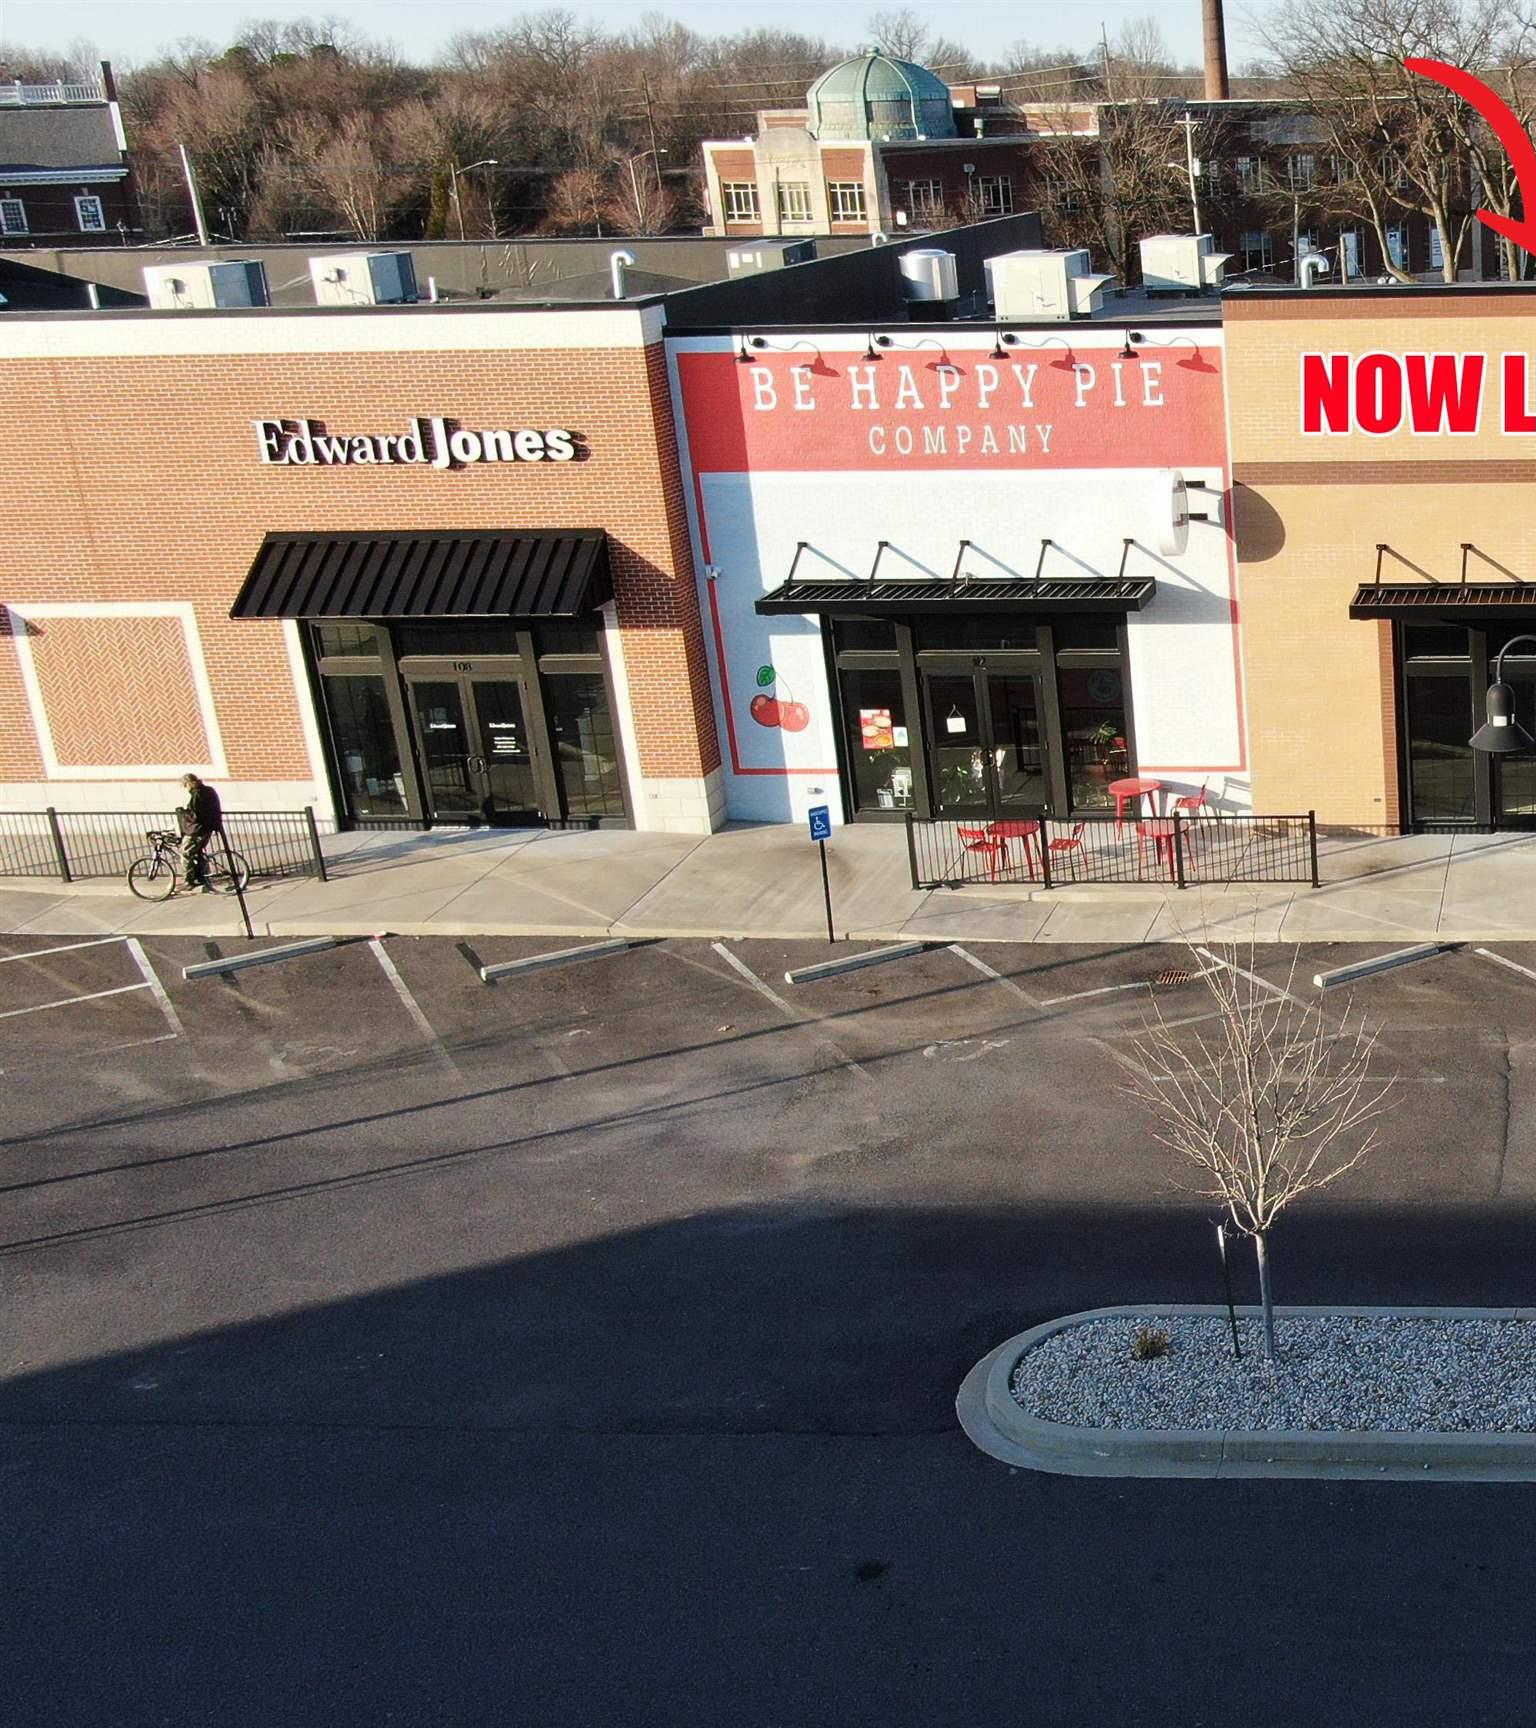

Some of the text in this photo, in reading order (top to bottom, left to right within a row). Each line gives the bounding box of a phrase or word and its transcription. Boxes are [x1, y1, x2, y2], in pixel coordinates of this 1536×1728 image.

[750, 362, 1164, 411] BE HAPPY PIE
[868, 424, 1054, 456] COMPANY
